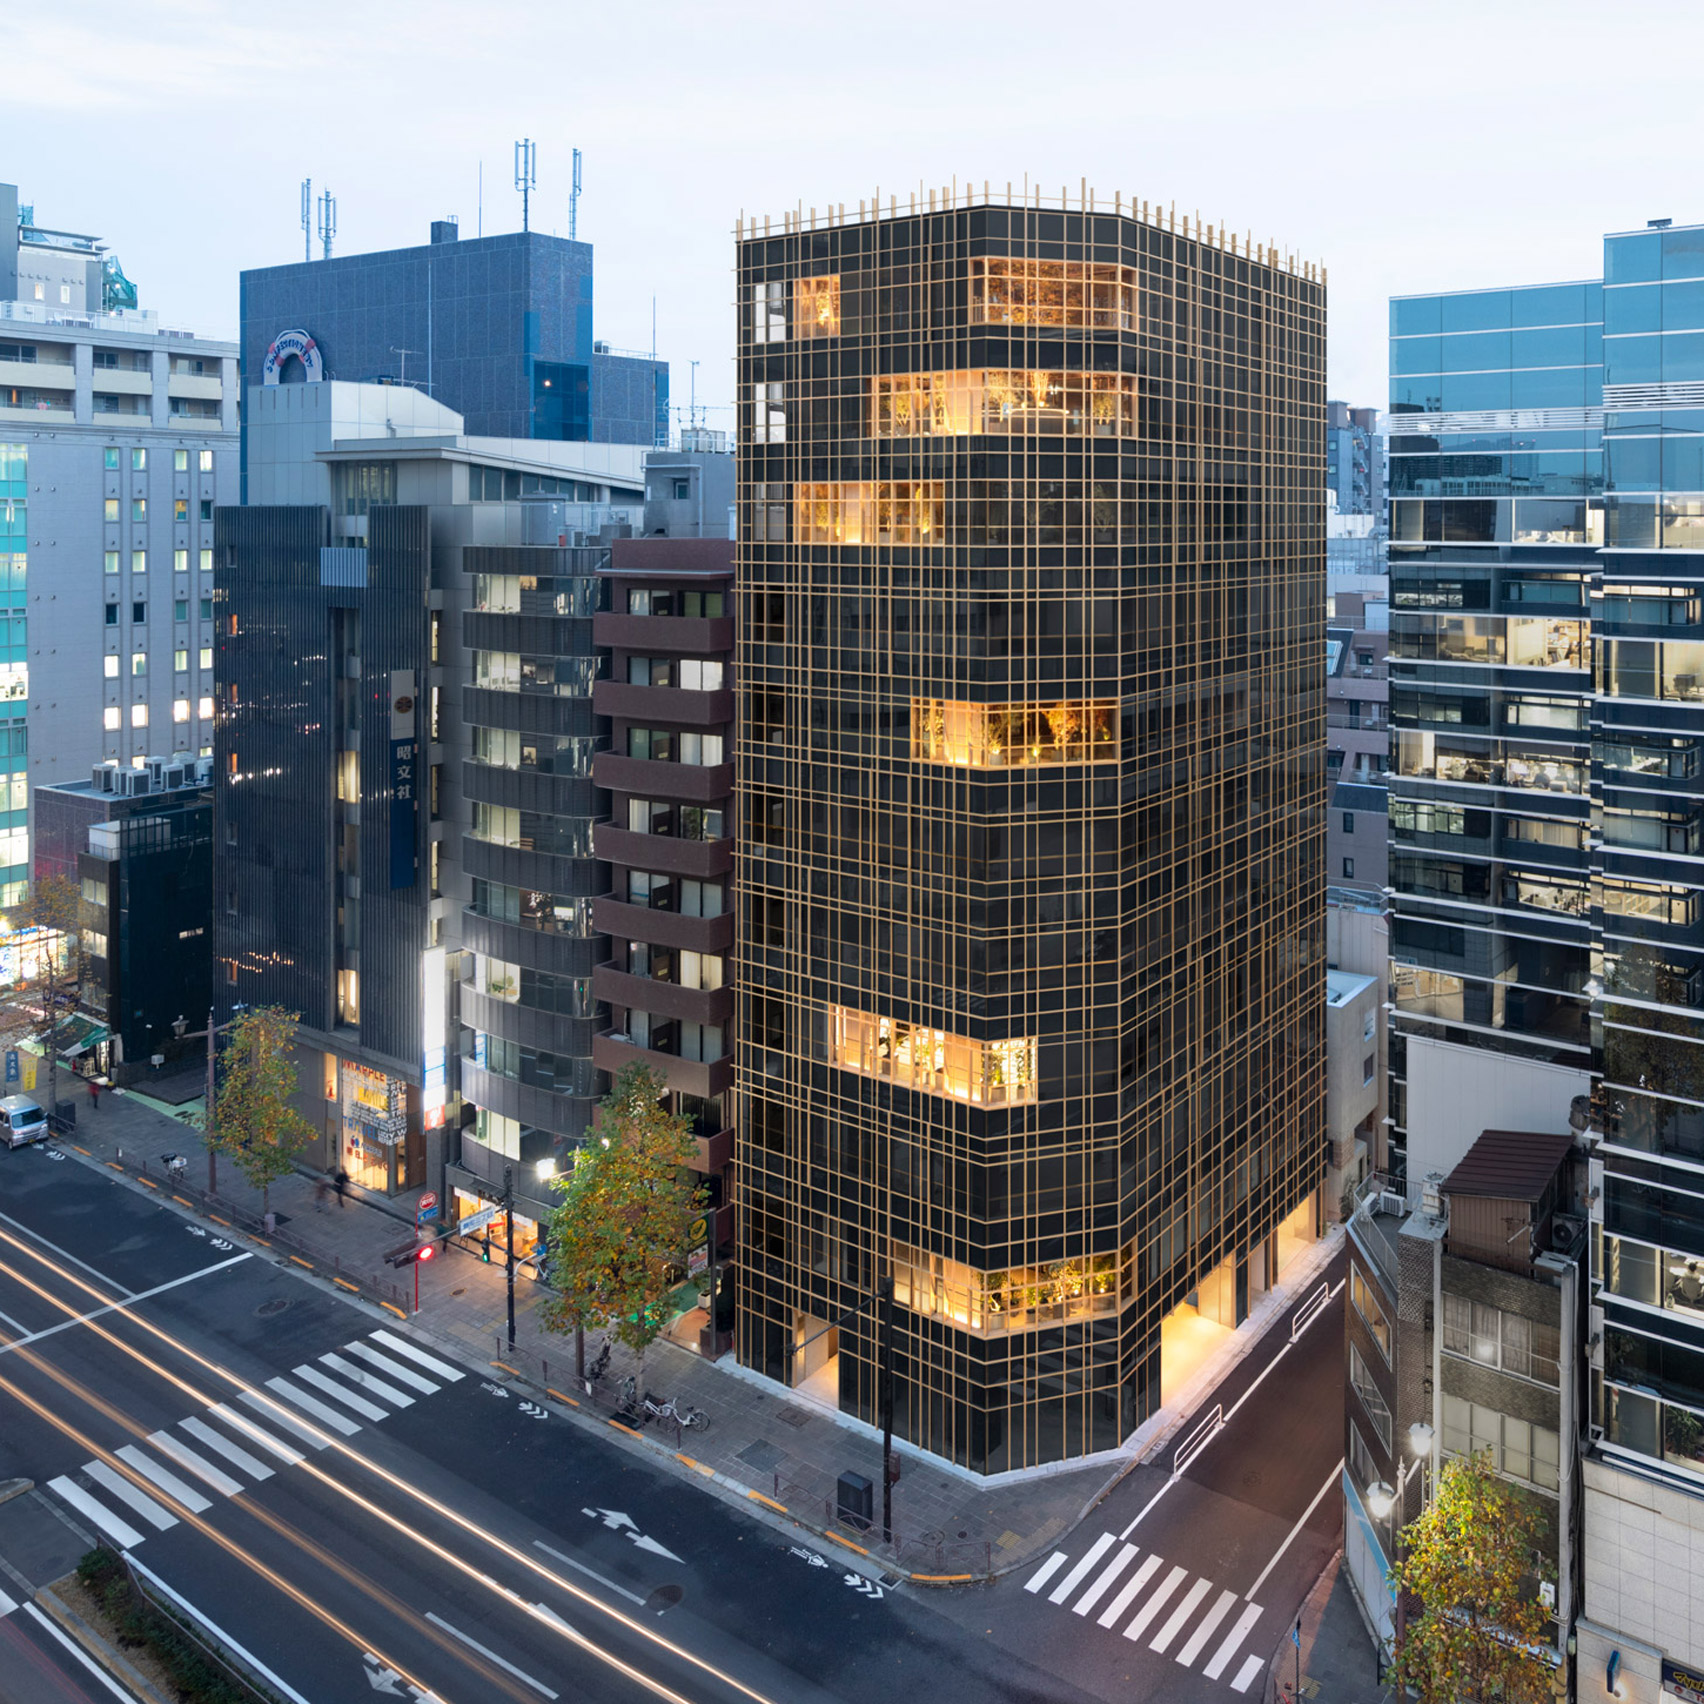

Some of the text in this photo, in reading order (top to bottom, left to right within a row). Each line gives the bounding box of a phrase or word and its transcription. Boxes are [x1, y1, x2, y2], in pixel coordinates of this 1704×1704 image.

[396, 745, 411, 800] 昭文社
[343, 1060, 385, 1082] MAPPLE
